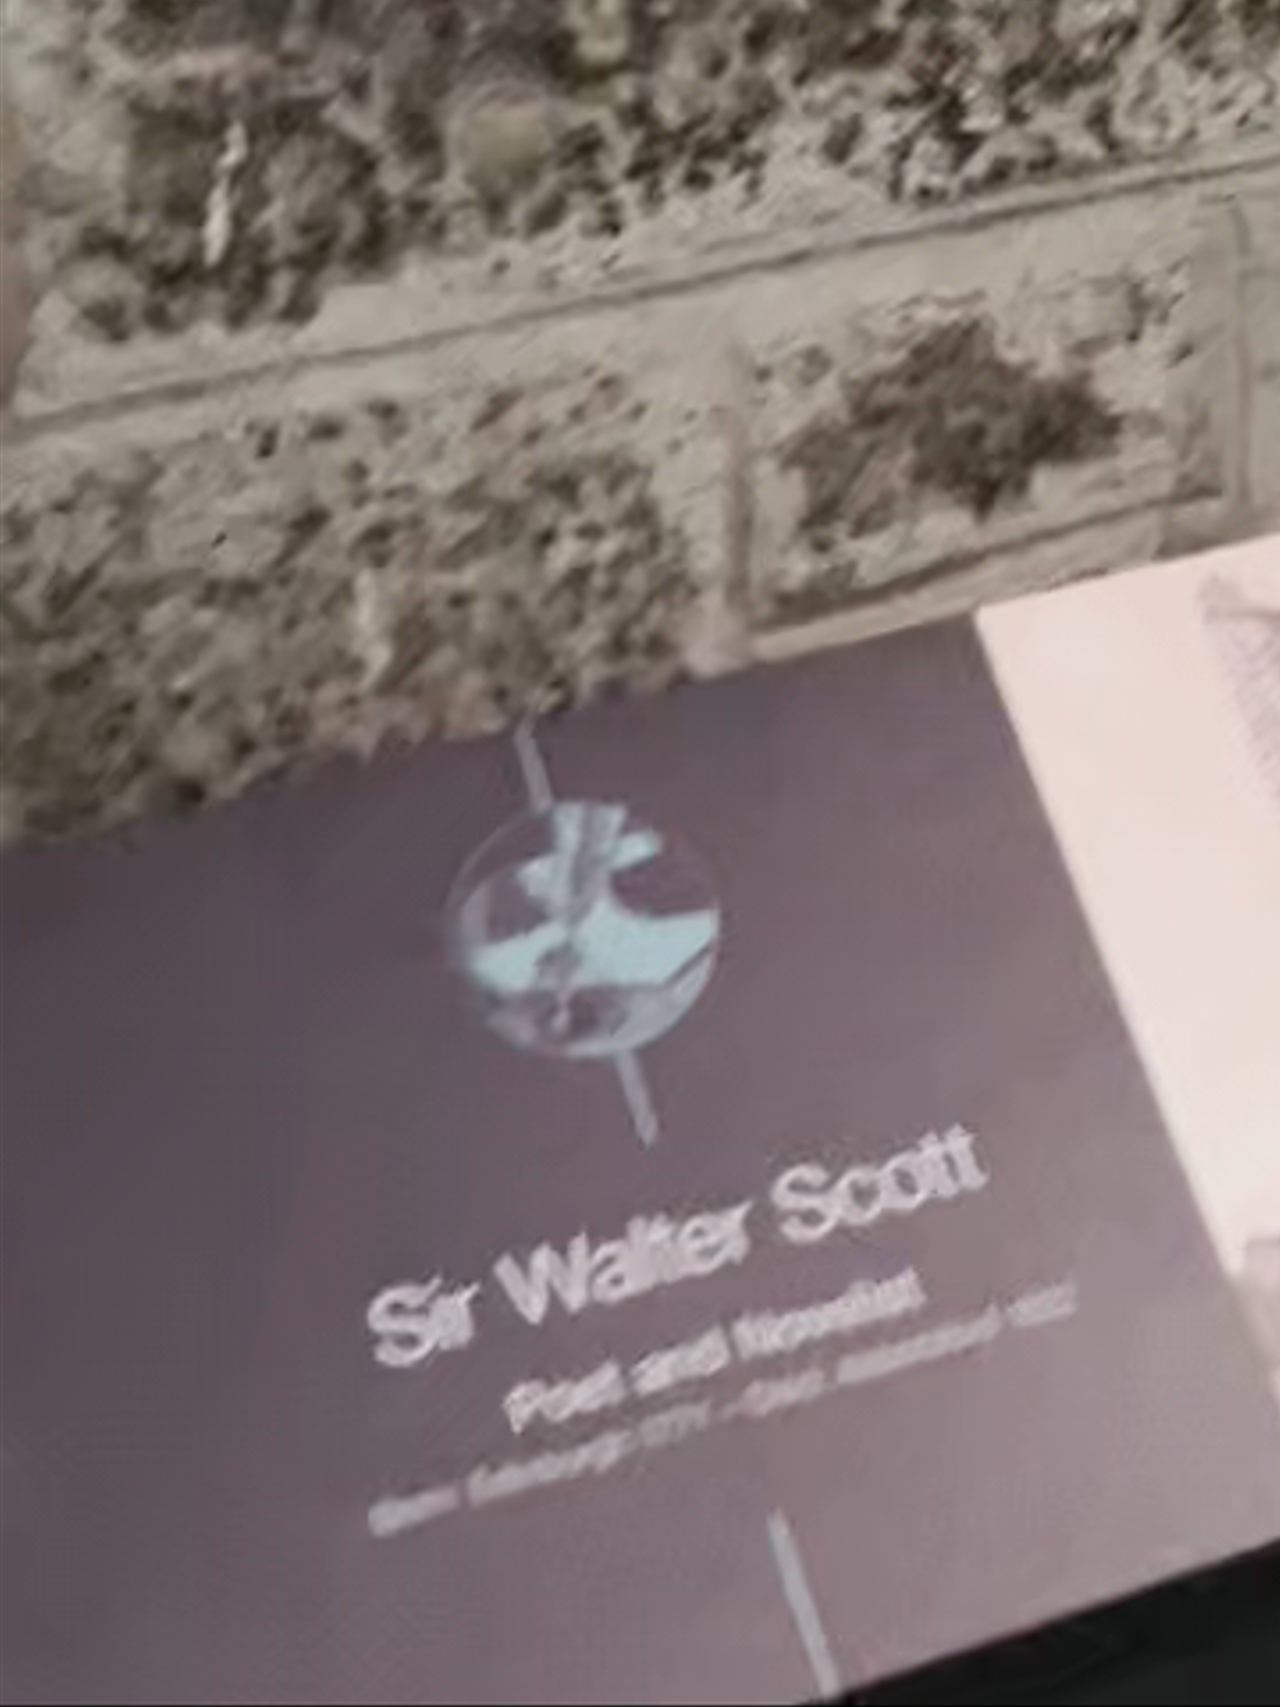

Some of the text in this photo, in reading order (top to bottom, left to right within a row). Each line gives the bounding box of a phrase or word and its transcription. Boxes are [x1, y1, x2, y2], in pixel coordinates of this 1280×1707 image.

[367, 1123, 990, 1368] Sir Walter Scott
